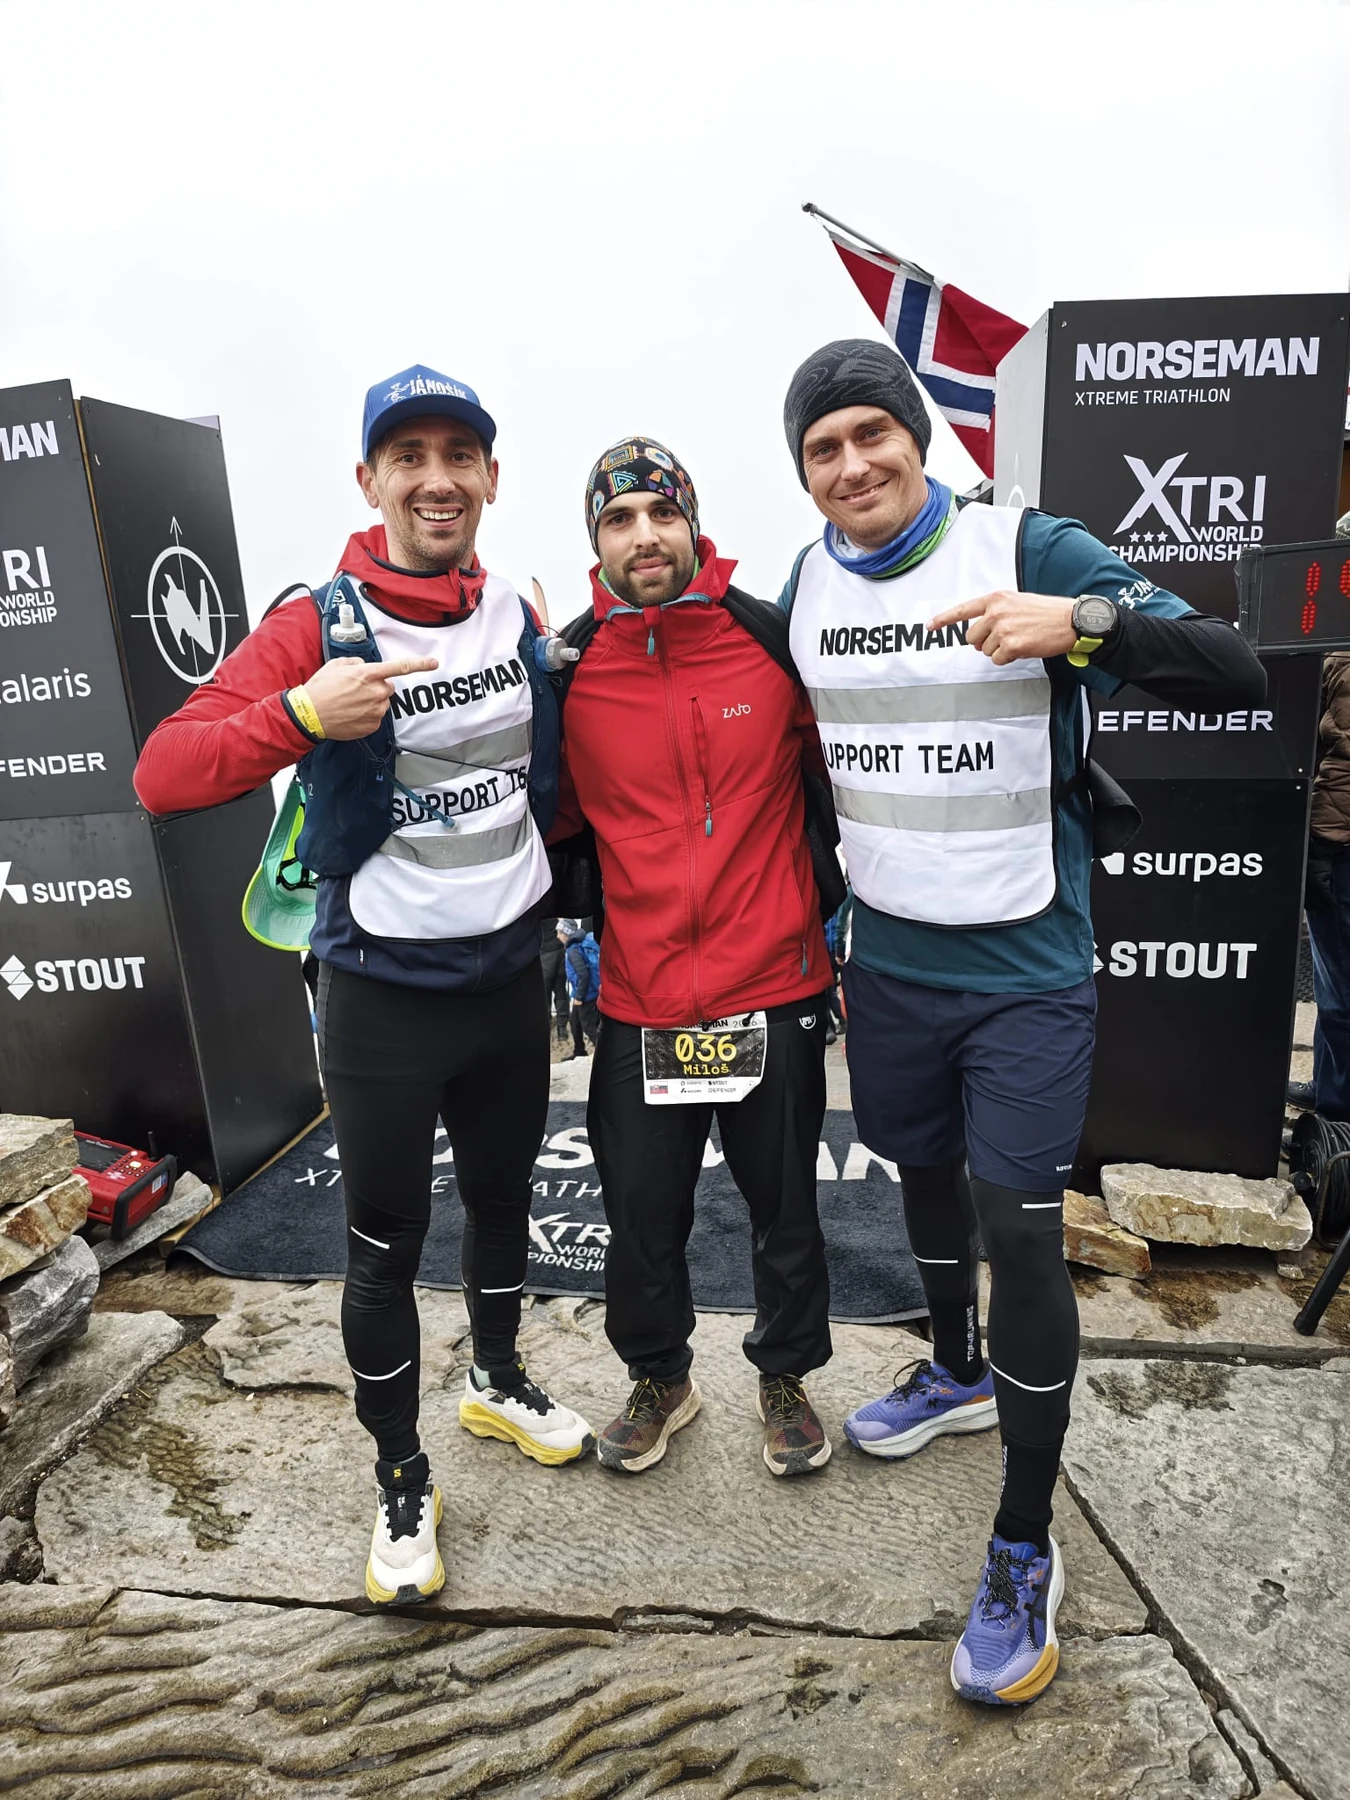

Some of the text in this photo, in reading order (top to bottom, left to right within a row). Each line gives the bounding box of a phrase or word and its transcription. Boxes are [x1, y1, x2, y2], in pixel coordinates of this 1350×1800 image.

[1075, 337, 1320, 381] NORSEMAN
[1075, 388, 1231, 406] XTREME TRIATHLON
[1113, 452, 1266, 542] XTRI
[1190, 525, 1264, 543] WORLD
[1109, 543, 1261, 563] HAMPIONSH
[0, 591, 55, 610] WORLD
[820, 619, 969, 656] NORSEMAN
[0, 667, 92, 704] alaris
[389, 658, 527, 720] NORSEMAN
[1098, 710, 1274, 732] EFENDER
[823, 740, 994, 774] UPPORT TEAM
[392, 777, 499, 825] SUPPORT
[1132, 852, 1263, 882] surpas
[32, 877, 133, 907] surpas
[35, 956, 146, 993] STOUT
[1109, 941, 1257, 979] STOUT
[675, 1033, 737, 1062] 036
[683, 1063, 730, 1075] Miloš
[528, 1212, 612, 1246] XTR
